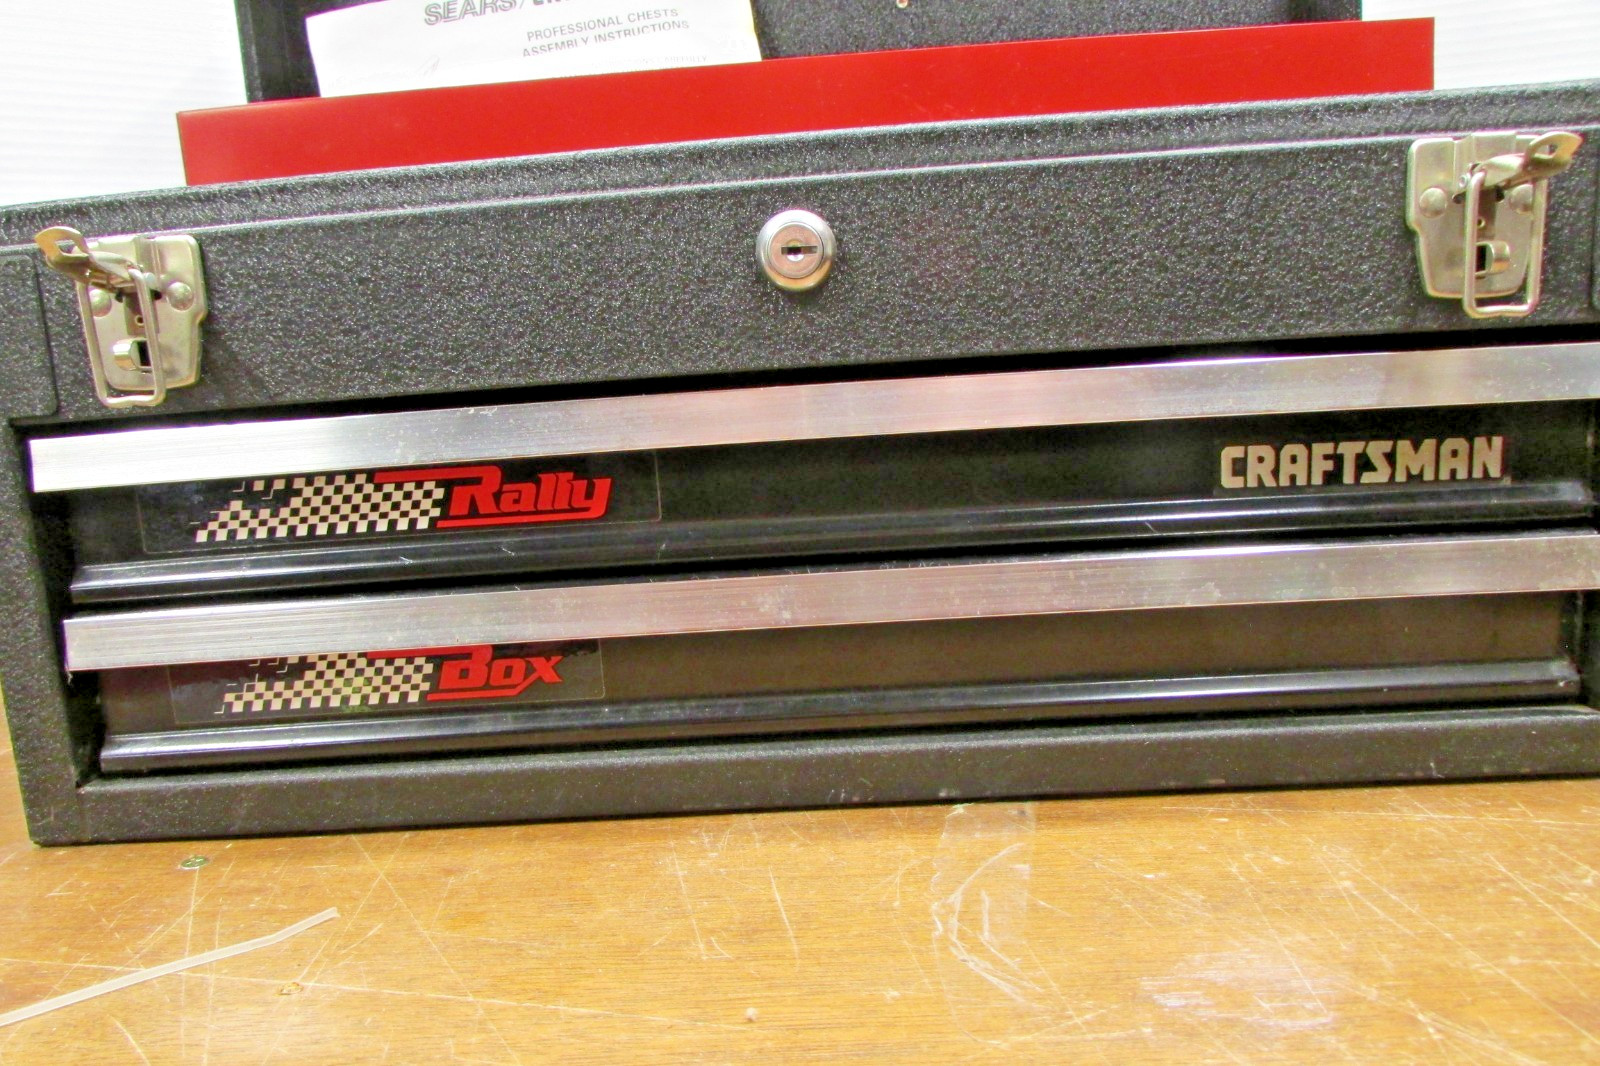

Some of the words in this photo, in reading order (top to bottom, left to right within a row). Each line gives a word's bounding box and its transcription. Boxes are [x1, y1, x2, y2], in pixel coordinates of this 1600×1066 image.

[526, 14, 623, 42] PROFESSIONAL
[627, 8, 679, 24] CHESTS
[593, 20, 690, 43] INSTRUCTIONS
[1220, 435, 1504, 489] CRAFTSMAN
[436, 465, 613, 528] Rally
[427, 644, 563, 701] Box
